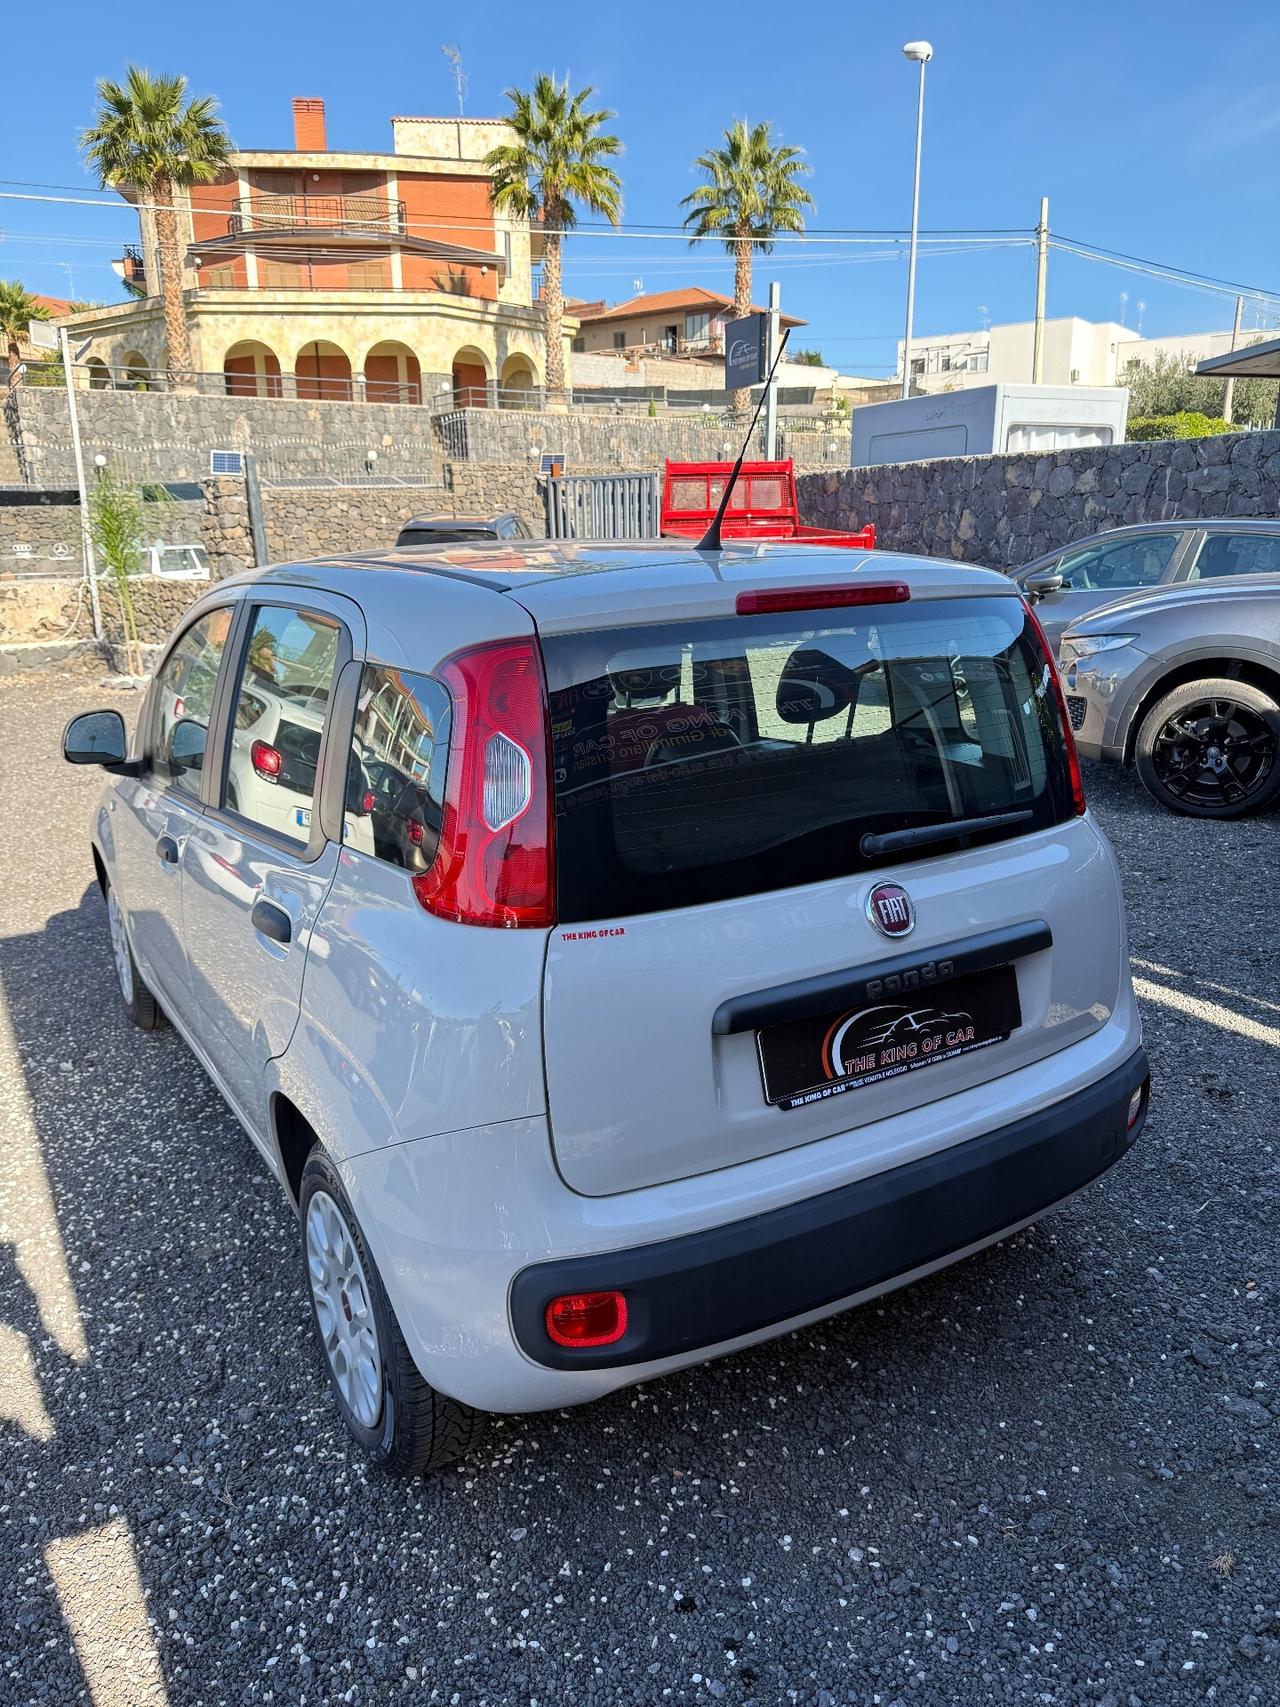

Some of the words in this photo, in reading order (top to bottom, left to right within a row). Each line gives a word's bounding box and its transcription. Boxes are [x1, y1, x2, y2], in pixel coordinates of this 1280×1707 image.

[878, 896, 908, 925] FIAT
[562, 932, 577, 942] THE
[578, 931, 597, 940] KING
[599, 929, 609, 938] OF
[609, 928, 625, 937] CAR
[845, 1053, 876, 1075] THE
[881, 1042, 918, 1065] KING
[922, 1034, 943, 1053] OF
[946, 1026, 975, 1046] CAR
[791, 1097, 804, 1107] THE
[804, 1092, 822, 1104] KING
[822, 1089, 832, 1097] OF
[832, 1084, 846, 1094] CAR
